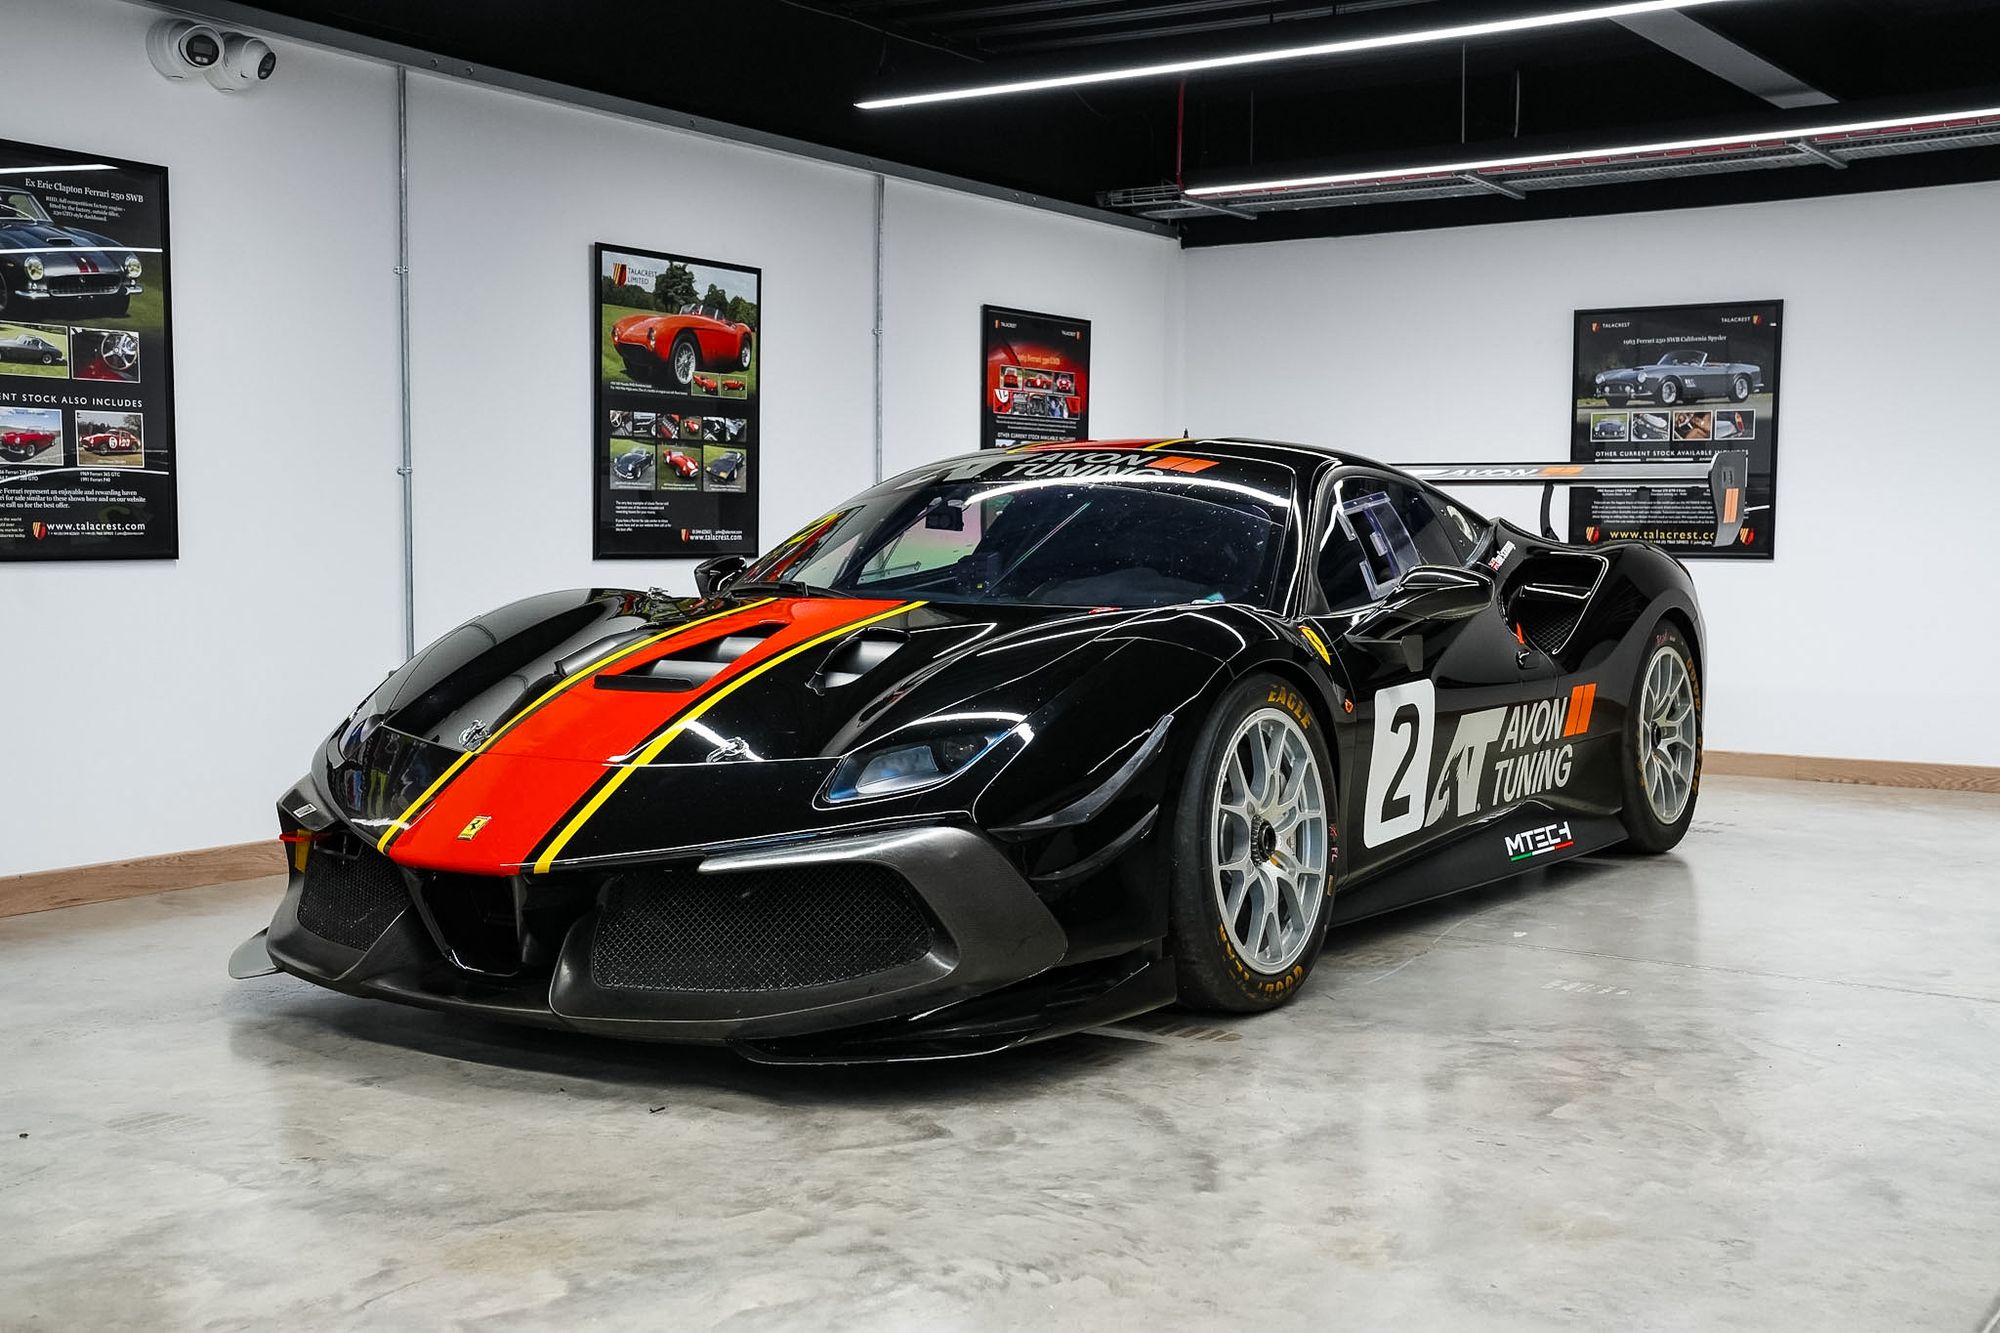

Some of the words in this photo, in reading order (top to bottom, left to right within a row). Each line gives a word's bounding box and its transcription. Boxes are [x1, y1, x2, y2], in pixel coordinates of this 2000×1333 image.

[26, 178, 36, 188] Ex
[37, 180, 53, 190] Eric
[54, 182, 83, 195] Clapton
[84, 186, 110, 199] Ferrari
[111, 192, 125, 201] 250
[126, 193, 144, 203] SWB
[628, 267, 657, 278] TALACREST
[1680, 334, 1707, 342] California
[1707, 334, 1727, 343] Spyder
[22, 394, 57, 403] STOCK
[61, 396, 87, 405] ALSO
[92, 398, 142, 408] INCLUDES
[1025, 452, 1161, 465] AVON
[1002, 463, 1165, 477] TUNING
[4, 488, 23, 496] Ferrari
[24, 489, 49, 498] represent
[58, 488, 83, 498] enjoyable
[95, 489, 121, 499] rewarding
[68, 494, 85, 502] shown
[47, 521, 146, 531] www.talacrest.com
[1610, 530, 1714, 540] www.talacrest.c
[1267, 684, 1313, 729] EAGLE
[1501, 697, 1568, 752] AVON
[1381, 703, 1420, 823] 2
[1492, 743, 1573, 806] TUNING
[1505, 822, 1573, 857] MTECH
